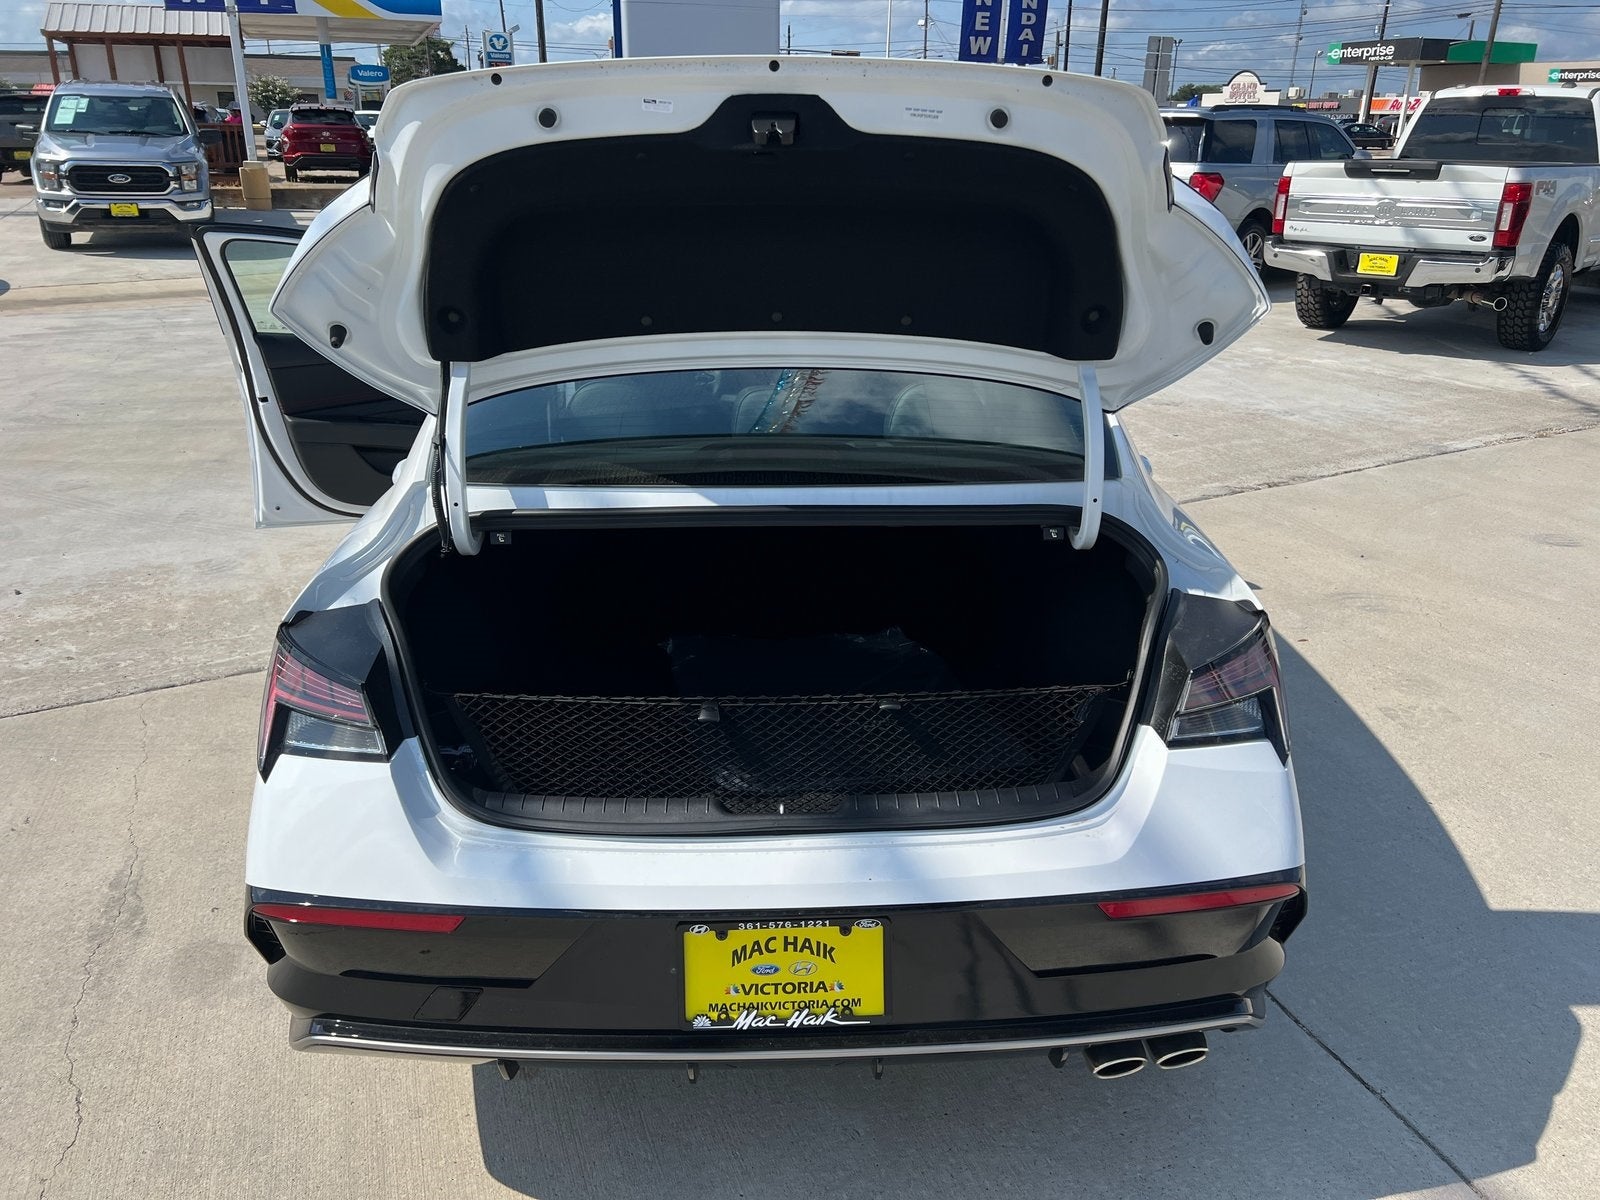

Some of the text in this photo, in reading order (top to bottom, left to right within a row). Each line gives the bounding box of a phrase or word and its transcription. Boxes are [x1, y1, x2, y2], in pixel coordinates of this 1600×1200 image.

[1327, 43, 1395, 59] enterprise
[357, 69, 383, 77] Valero
[1548, 70, 1600, 81] enterprise
[738, 920, 830, 930] 361-576-1221
[731, 936, 836, 967] MAC HAIK
[740, 981, 828, 996] VICTORIA
[733, 1008, 850, 1030] Mac Haik
